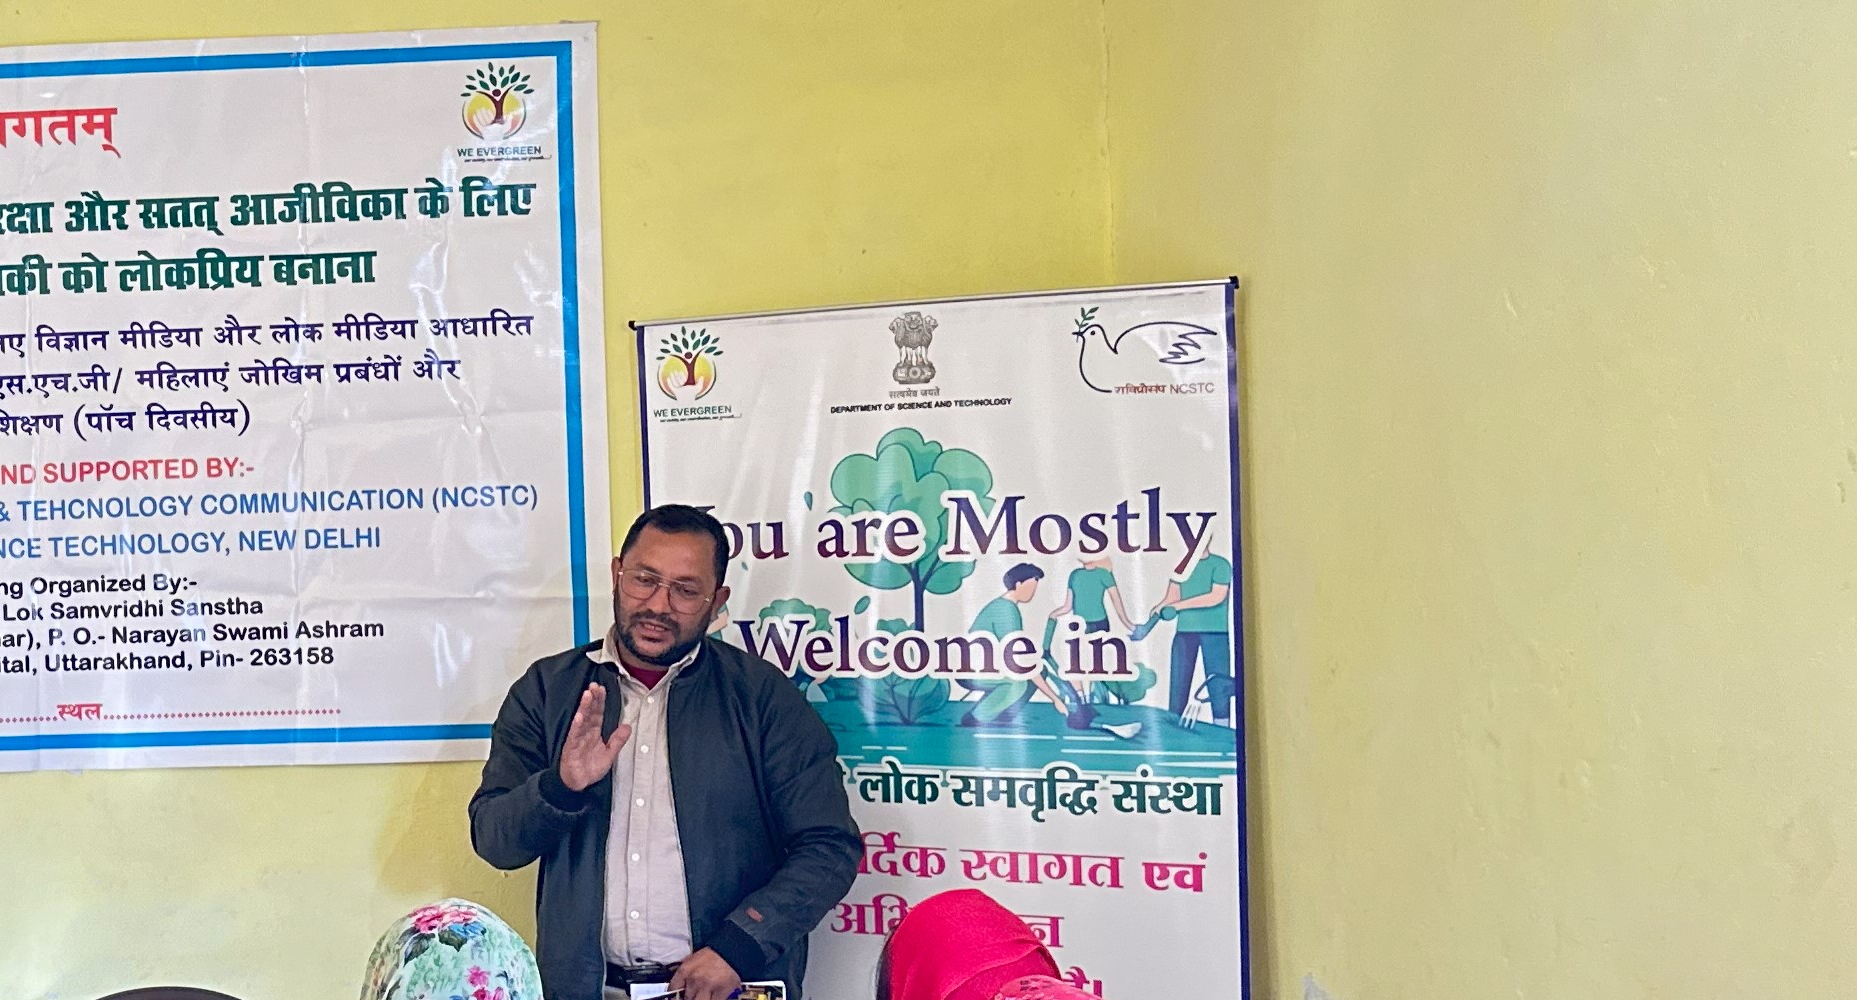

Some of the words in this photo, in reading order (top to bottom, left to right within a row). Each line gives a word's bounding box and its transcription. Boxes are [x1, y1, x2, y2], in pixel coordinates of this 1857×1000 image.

[457, 148, 474, 157] WE
[476, 145, 542, 157] EVERGREEN
[64, 189, 130, 233] और
[138, 195, 225, 236] सतत्
[231, 181, 408, 227] आजीविका
[414, 177, 451, 219] के
[459, 175, 537, 218] लिए
[58, 252, 109, 295] को
[116, 247, 265, 291] लोकप्रिय
[269, 250, 378, 287] बनाना
[35, 325, 107, 352] विज्ञान
[119, 320, 203, 350] मीडिया
[213, 314, 262, 347] और
[270, 316, 324, 345] लोक
[332, 313, 419, 342] मीडिया
[429, 308, 534, 337] आधारित
[135, 361, 231, 393] महिलाएं
[239, 358, 324, 387] जोखिम
[332, 354, 404, 384] प्रबंधों
[412, 348, 461, 381] और
[1169, 382, 1215, 394] NCSTC
[145, 398, 252, 437] दिवसीय)
[653, 409, 668, 418] WE
[670, 405, 732, 417] EVERGREEN
[830, 403, 882, 414] DEPARTMENT
[884, 402, 895, 411] OF
[897, 401, 932, 411] SCIENCE
[934, 400, 952, 408] AND
[954, 397, 1012, 408] TECHNOLOGY
[43, 458, 199, 484] SUPPORTED
[206, 456, 255, 479] BY:-
[17, 494, 193, 522] TEHCNOLOGY
[200, 488, 424, 516] COMMUNICATION
[432, 484, 539, 513] (NCSTC)
[48, 531, 231, 558] TECHNOLOGY,
[238, 529, 297, 552] NEW
[305, 527, 381, 550] DELHI
[695, 505, 790, 560] ou
[816, 509, 920, 559] are
[947, 486, 1217, 576] Mostly
[30, 574, 146, 599] Organized
[153, 574, 197, 596] By:-
[3, 603, 44, 623] Lok
[50, 600, 164, 621] Samvridhi
[171, 597, 264, 618] Sanstha
[48, 627, 68, 647] P.
[73, 627, 106, 646] O.-
[112, 624, 206, 649] Narayan
[213, 622, 289, 643] Swami
[295, 620, 385, 639] Ashram
[733, 616, 1038, 677] Welcome
[1064, 621, 1132, 675] in
[45, 651, 193, 673] Uttarakhand,
[200, 649, 244, 669] Pin-
[250, 646, 335, 667] 263158
[857, 760, 940, 804] लोक
[949, 766, 1100, 823] समवृद्धि
[1111, 768, 1223, 816] संस्था
[959, 849, 1124, 889] स्वागत
[1141, 851, 1207, 893] एवं
